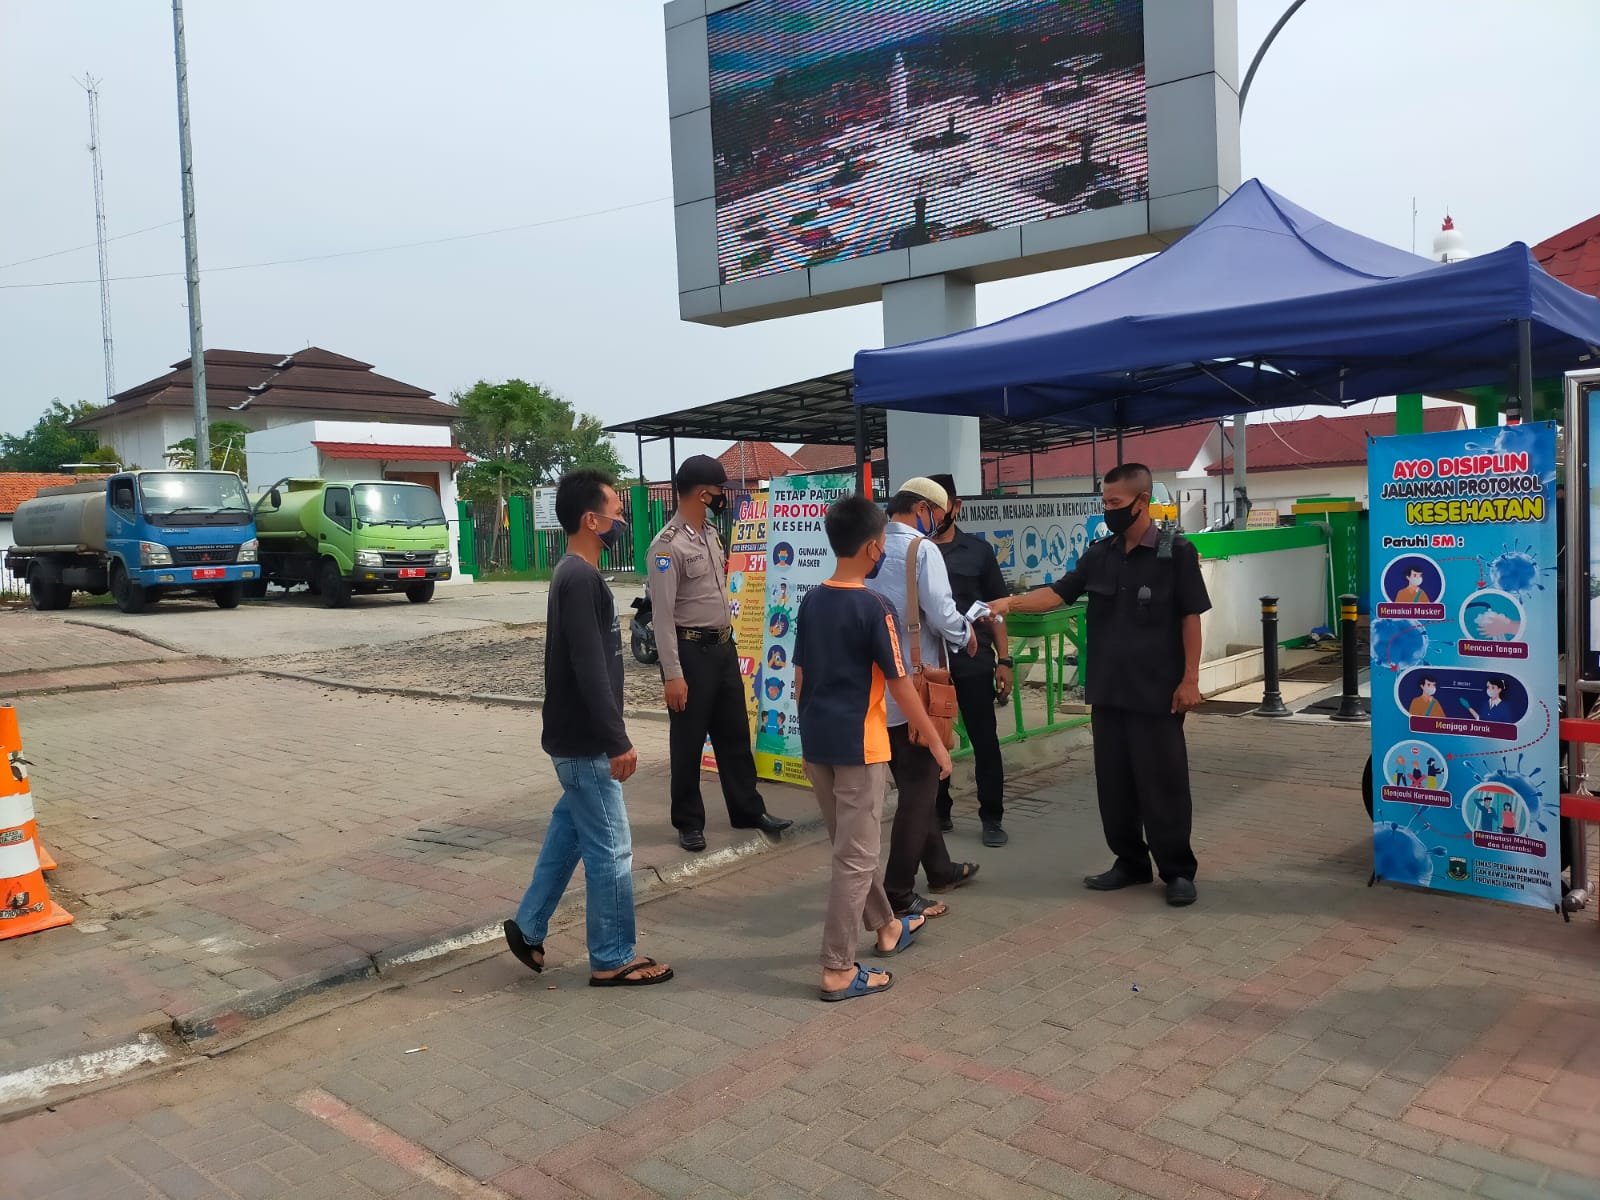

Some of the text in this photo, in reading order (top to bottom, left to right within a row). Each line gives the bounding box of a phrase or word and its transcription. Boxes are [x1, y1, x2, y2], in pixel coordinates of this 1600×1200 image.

[1393, 453, 1528, 479] AYO DISIPLIN
[1382, 476, 1542, 498] JALANKAN PROTOKOL
[775, 490, 806, 501] TETAP
[970, 506, 1001, 522] MASKER,
[1003, 504, 1034, 520] MENJAGA
[1035, 503, 1055, 518] JARAK
[1057, 504, 1061, 517] &
[1062, 503, 1089, 516] MENCUCI
[1406, 496, 1544, 524] KESEHATAN
[737, 523, 754, 540] 3T
[773, 521, 822, 532] KESEHA
[1383, 535, 1428, 548] Patuhi
[1431, 535, 1456, 547] 5M
[798, 547, 827, 556] GUNAKAN
[797, 559, 820, 567] MASKER
[1381, 607, 1441, 616] Memakai Masker
[1464, 643, 1522, 655] Mencuci Tangan
[1435, 721, 1491, 733] Menjaga Jarak
[1383, 788, 1450, 803] Menjauhi Kerumunan
